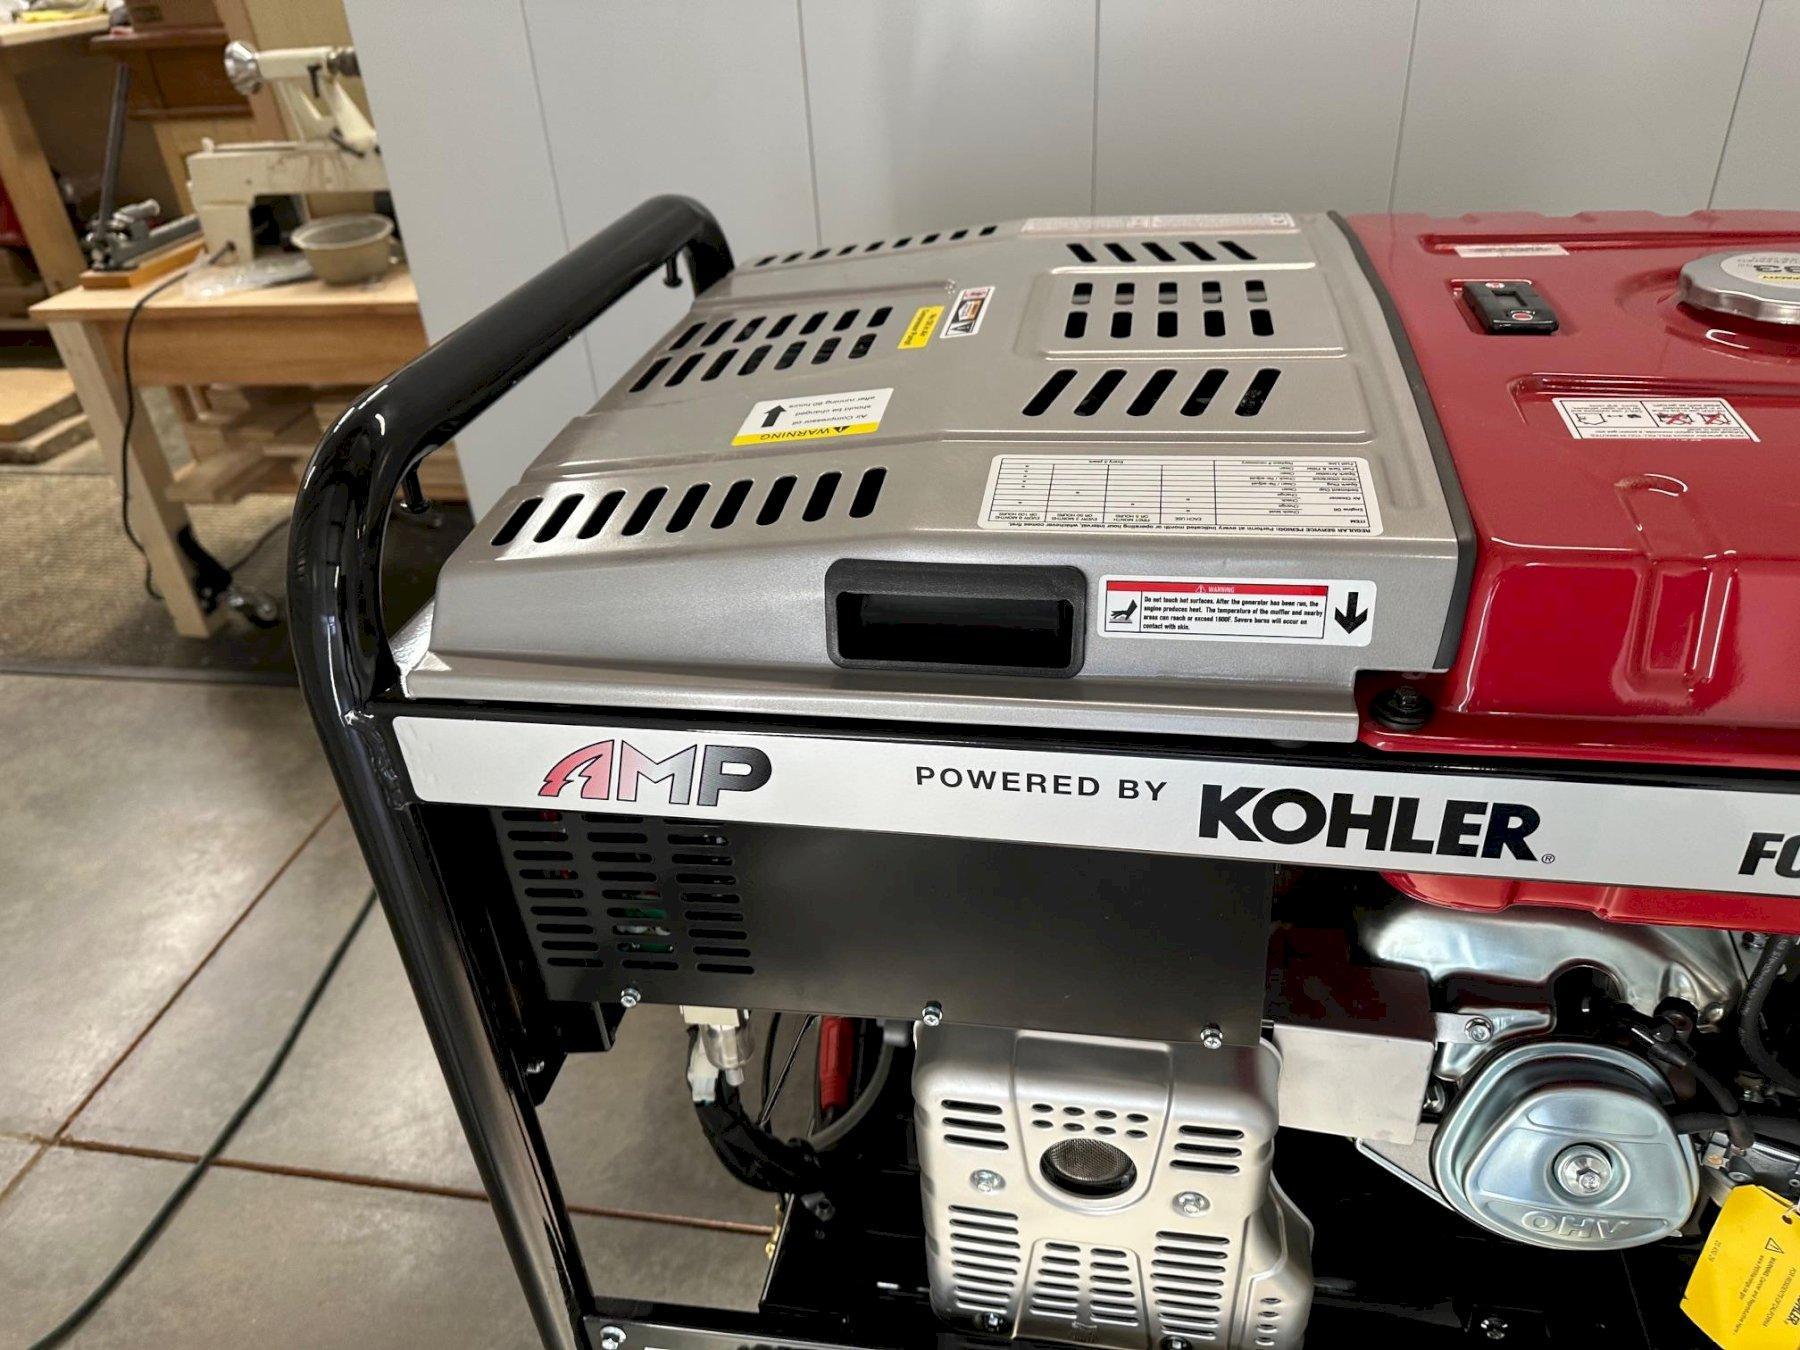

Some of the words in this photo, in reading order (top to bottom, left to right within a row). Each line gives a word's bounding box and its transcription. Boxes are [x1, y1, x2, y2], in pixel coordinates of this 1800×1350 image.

[760, 428, 830, 440] WARNING
[1208, 586, 1235, 594] WARNING
[1163, 606, 1188, 614] produces
[1217, 607, 1252, 615] temperature
[1303, 610, 1324, 618] nearby
[537, 739, 773, 807] AMP
[915, 765, 1100, 797] POWERED
[1118, 779, 1168, 802] BY
[1197, 784, 1539, 862] KOHLER
[1521, 1210, 1631, 1241] OHV
